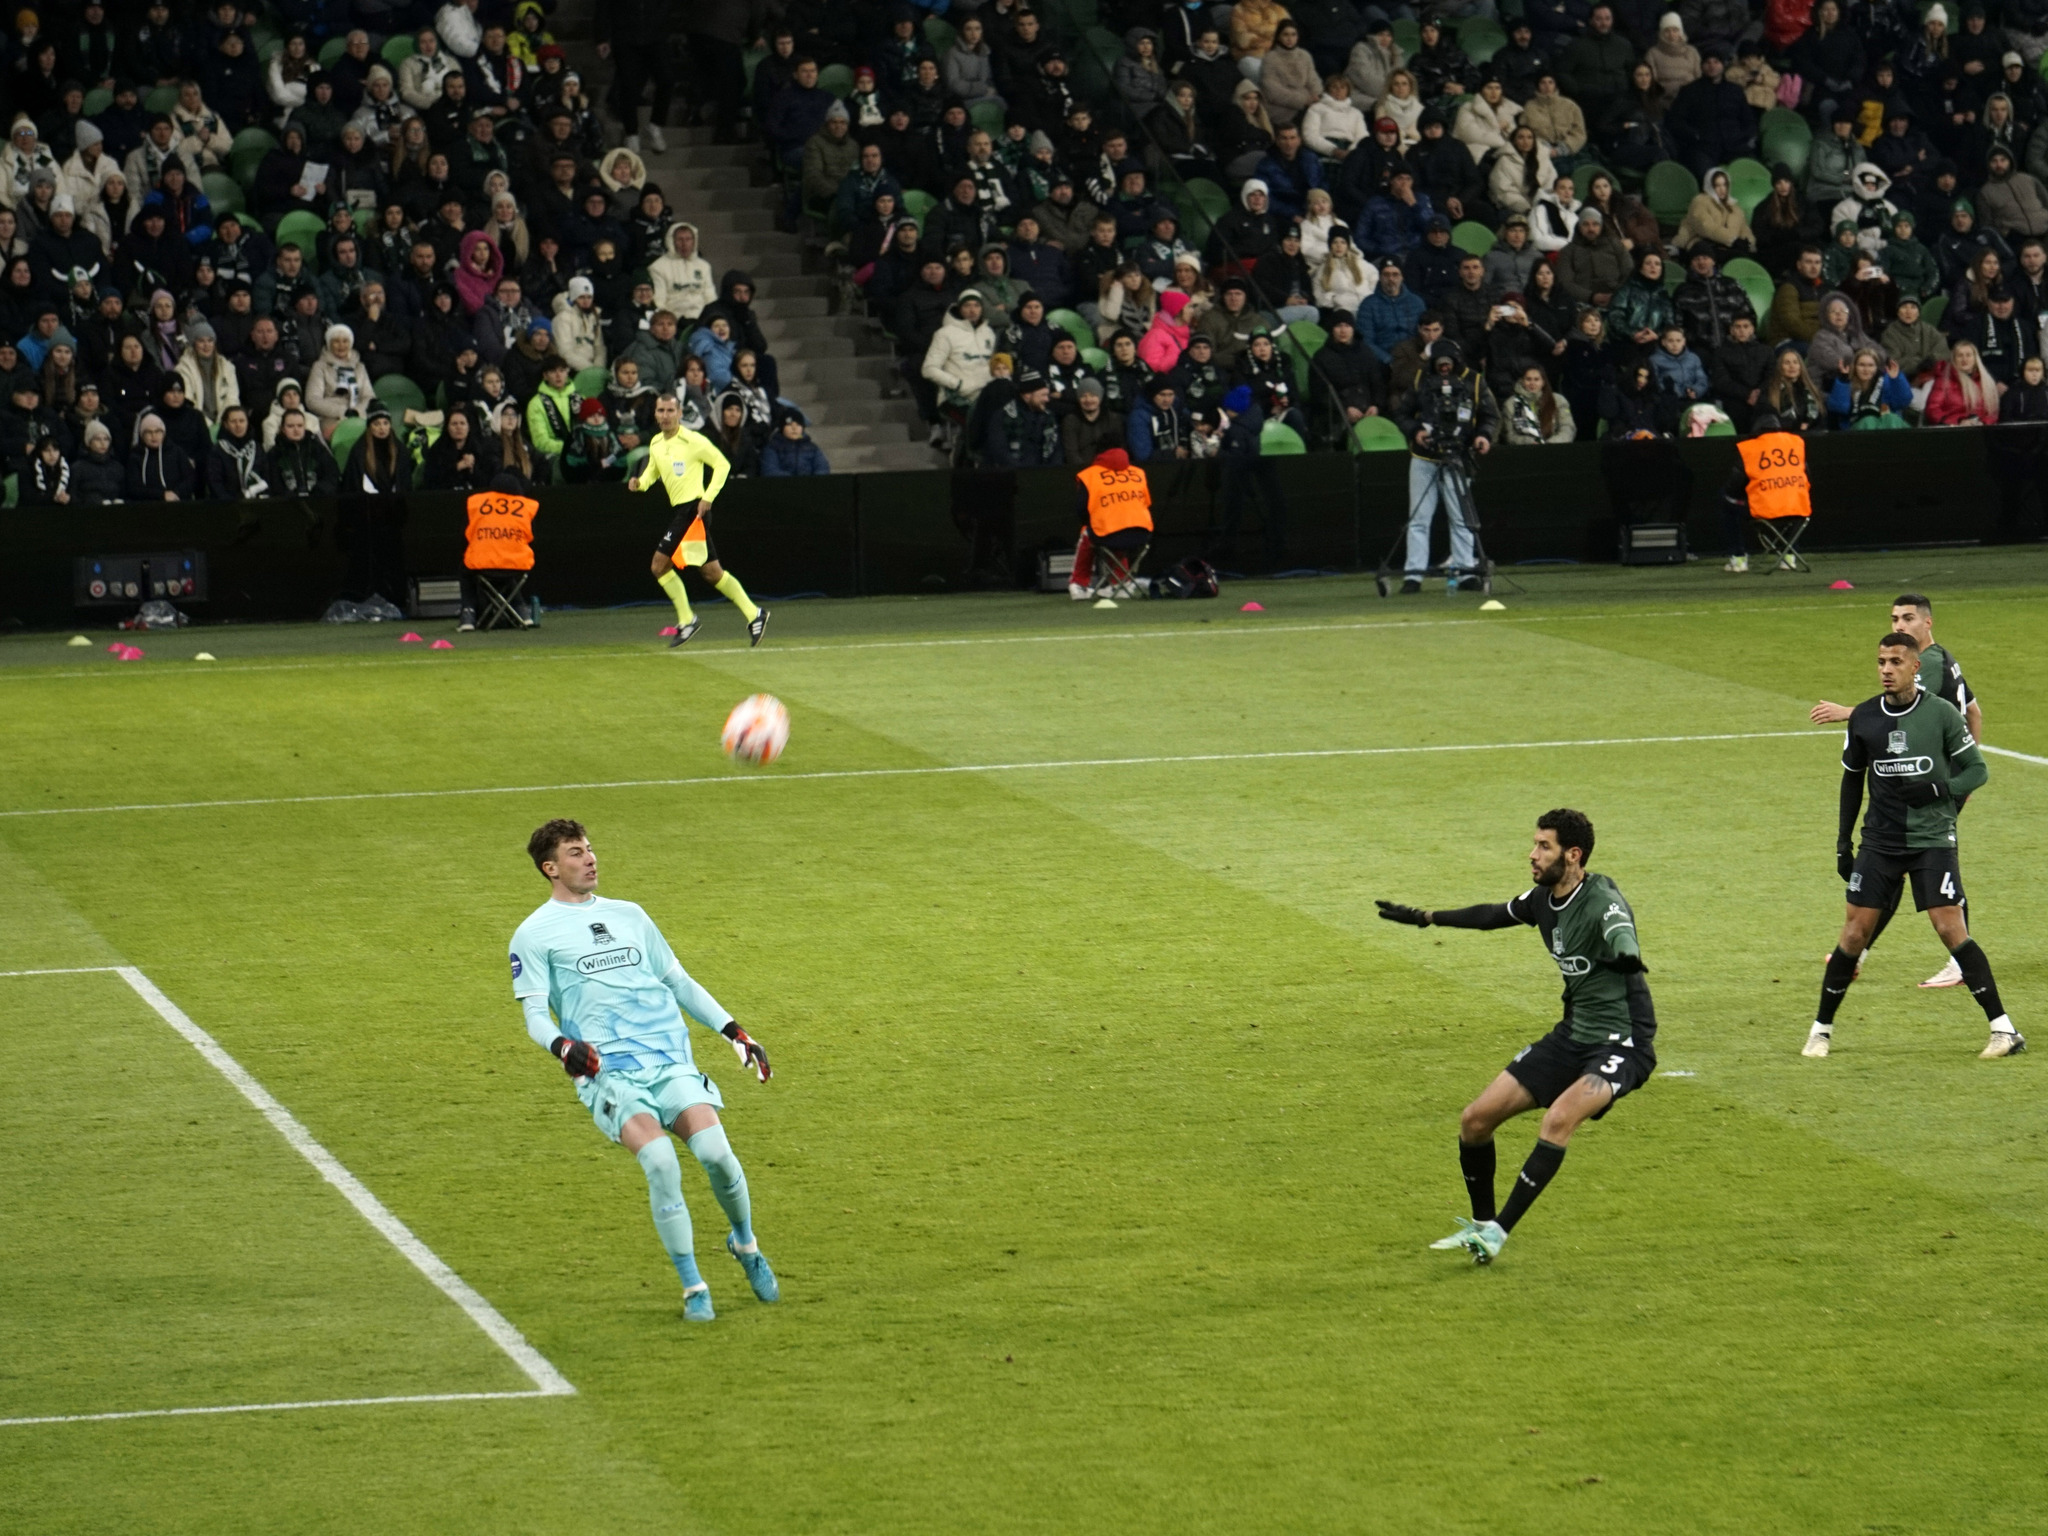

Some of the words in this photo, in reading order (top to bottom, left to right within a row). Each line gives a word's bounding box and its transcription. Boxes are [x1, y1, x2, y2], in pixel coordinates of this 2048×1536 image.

[1758, 448, 1800, 470] 636
[1100, 469, 1142, 486] 555
[479, 498, 524, 518] 632
[1100, 490, 1145, 508] СТЮАР
[1877, 763, 1915, 773] Winline
[1940, 872, 1956, 899] 4
[582, 954, 627, 970] Winline
[1600, 1054, 1625, 1074] 3
